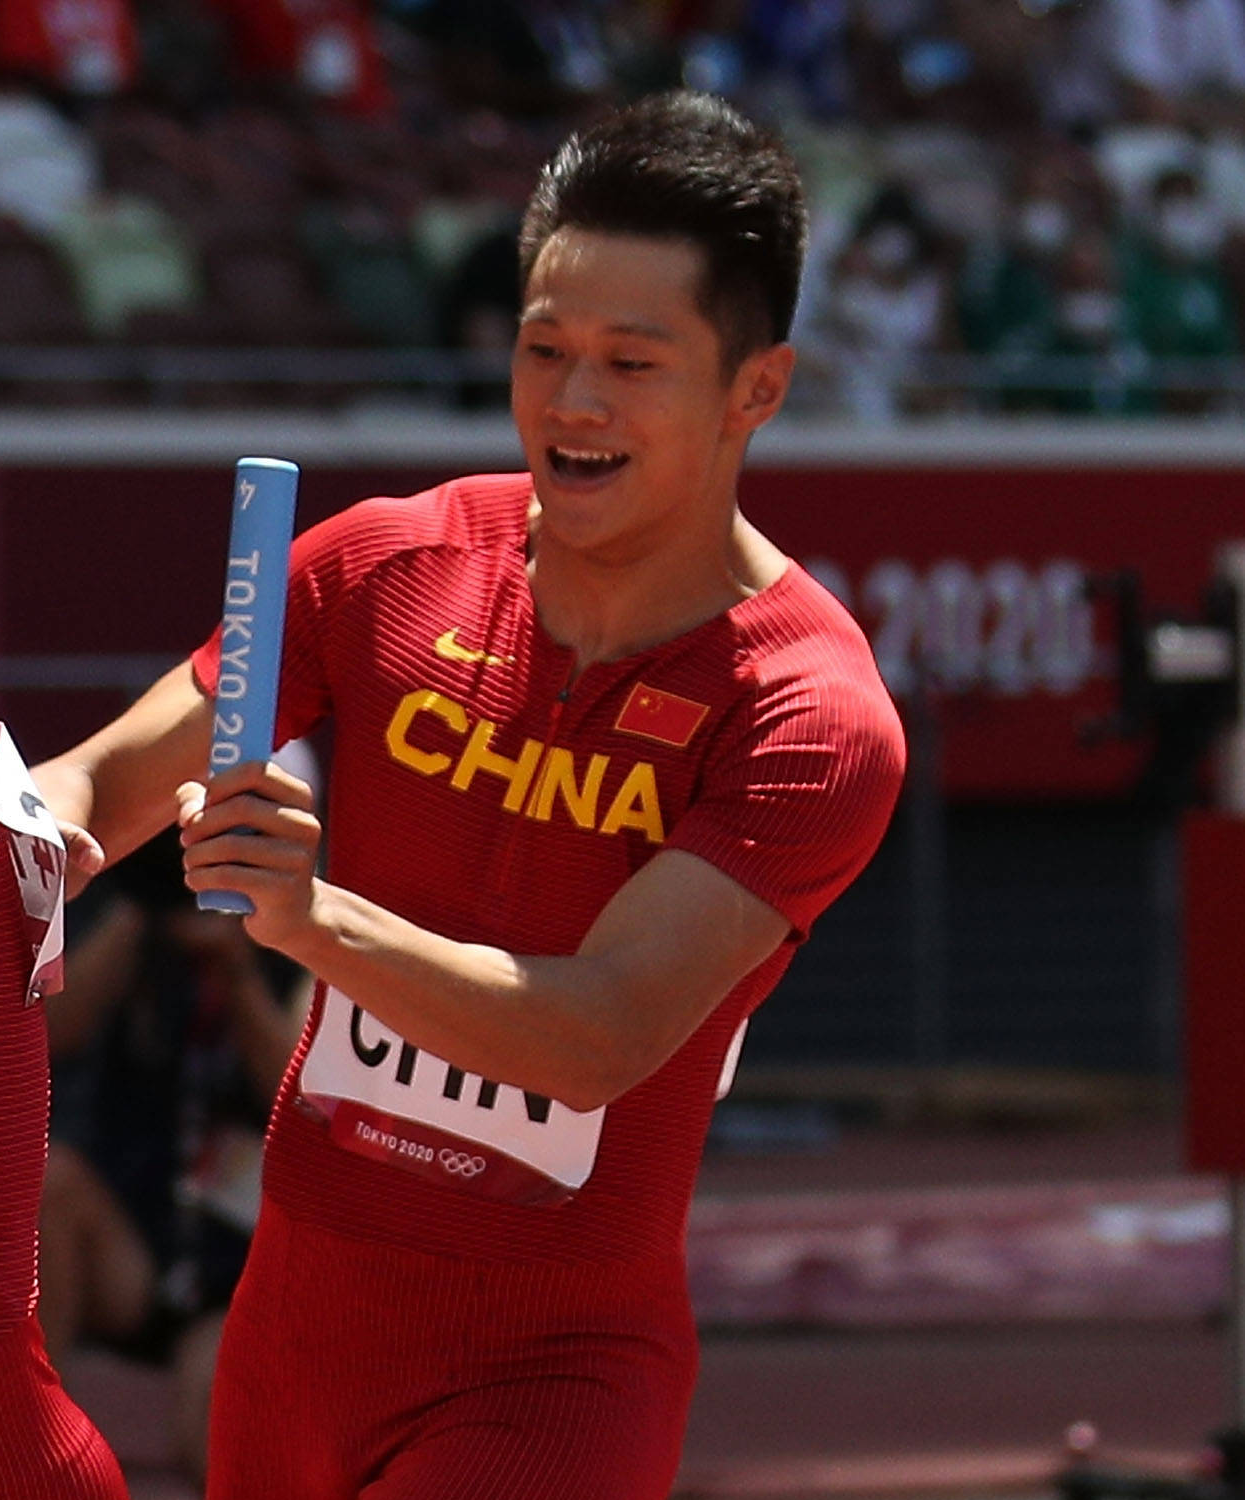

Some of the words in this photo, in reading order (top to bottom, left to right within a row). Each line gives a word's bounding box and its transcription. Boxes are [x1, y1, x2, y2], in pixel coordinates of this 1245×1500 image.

[217, 550, 260, 699] TOKYO
[865, 560, 1093, 692] 2020
[209, 712, 244, 779] 20
[356, 1121, 397, 1149] TOKYO
[399, 1139, 434, 1162] 2020
